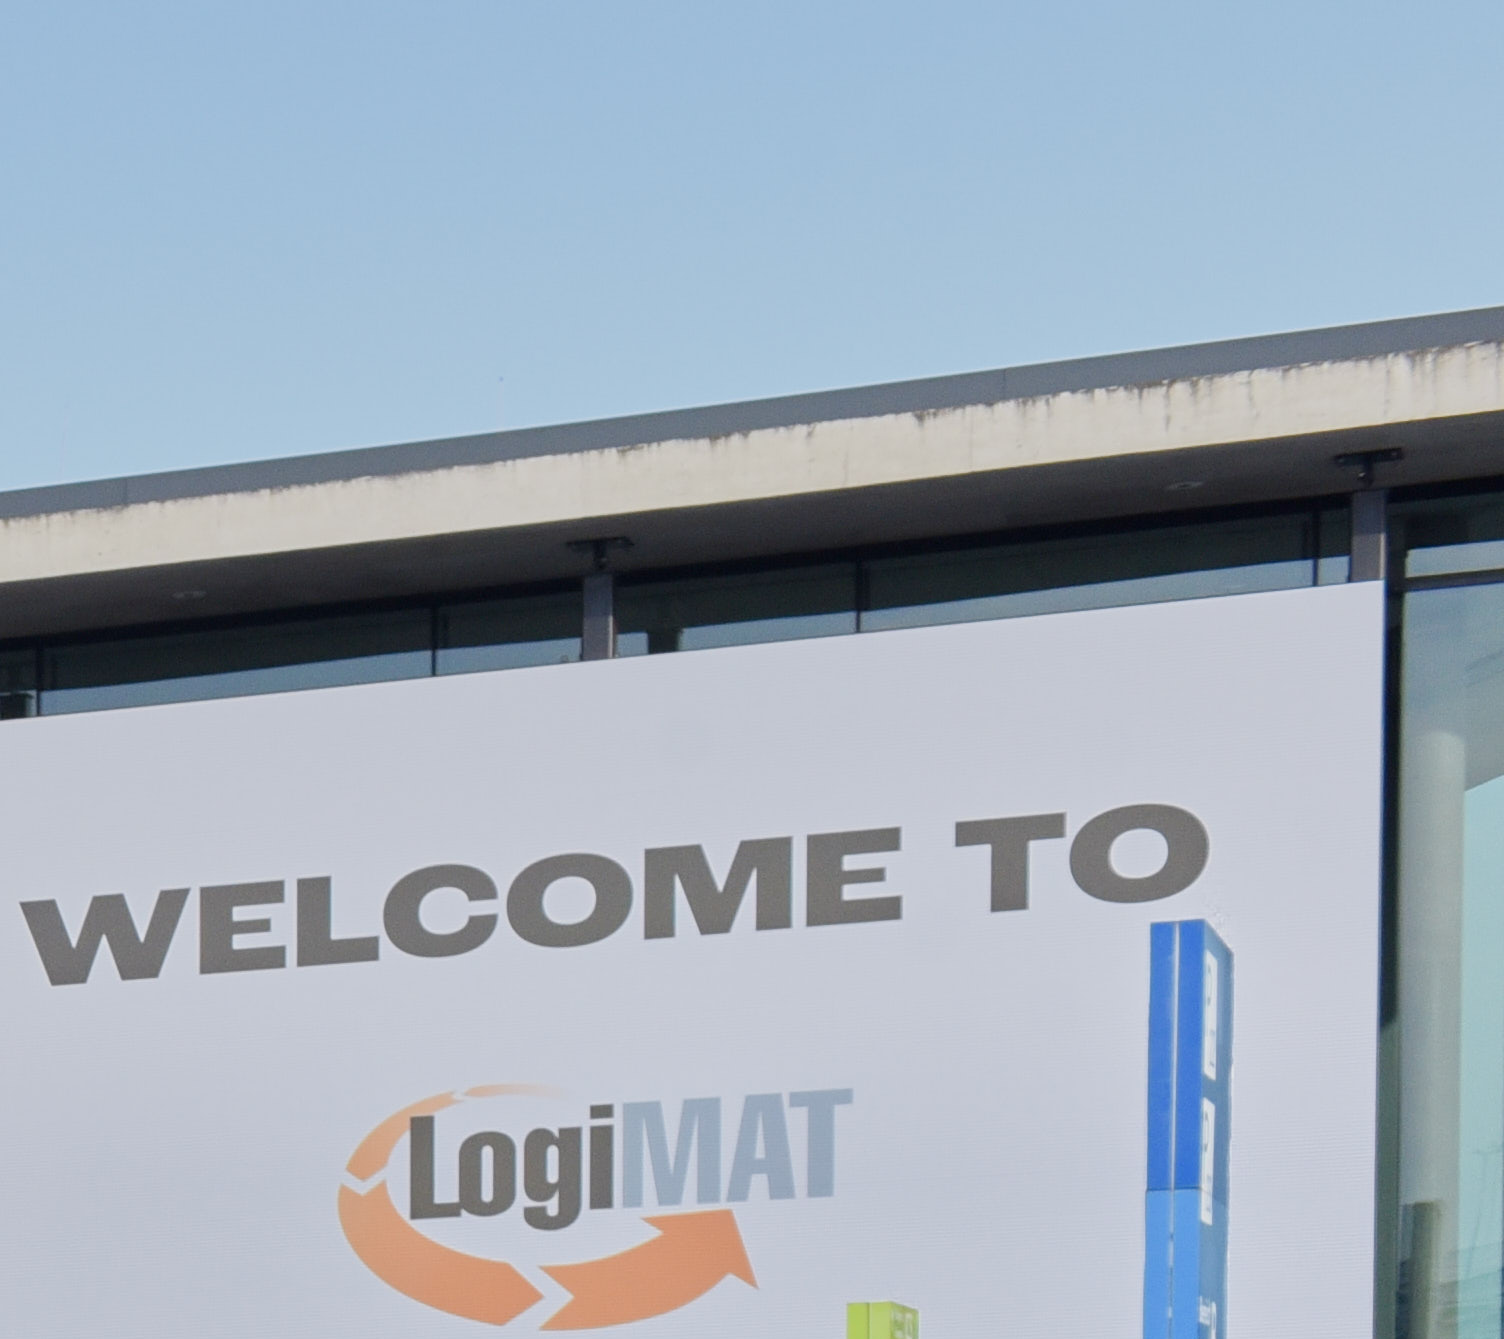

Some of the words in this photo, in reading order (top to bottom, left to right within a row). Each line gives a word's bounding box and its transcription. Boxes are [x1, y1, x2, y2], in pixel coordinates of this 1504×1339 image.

[19, 825, 903, 987] WELCOME
[954, 803, 1211, 914] TO
[406, 1087, 855, 1233] LogiMAT
